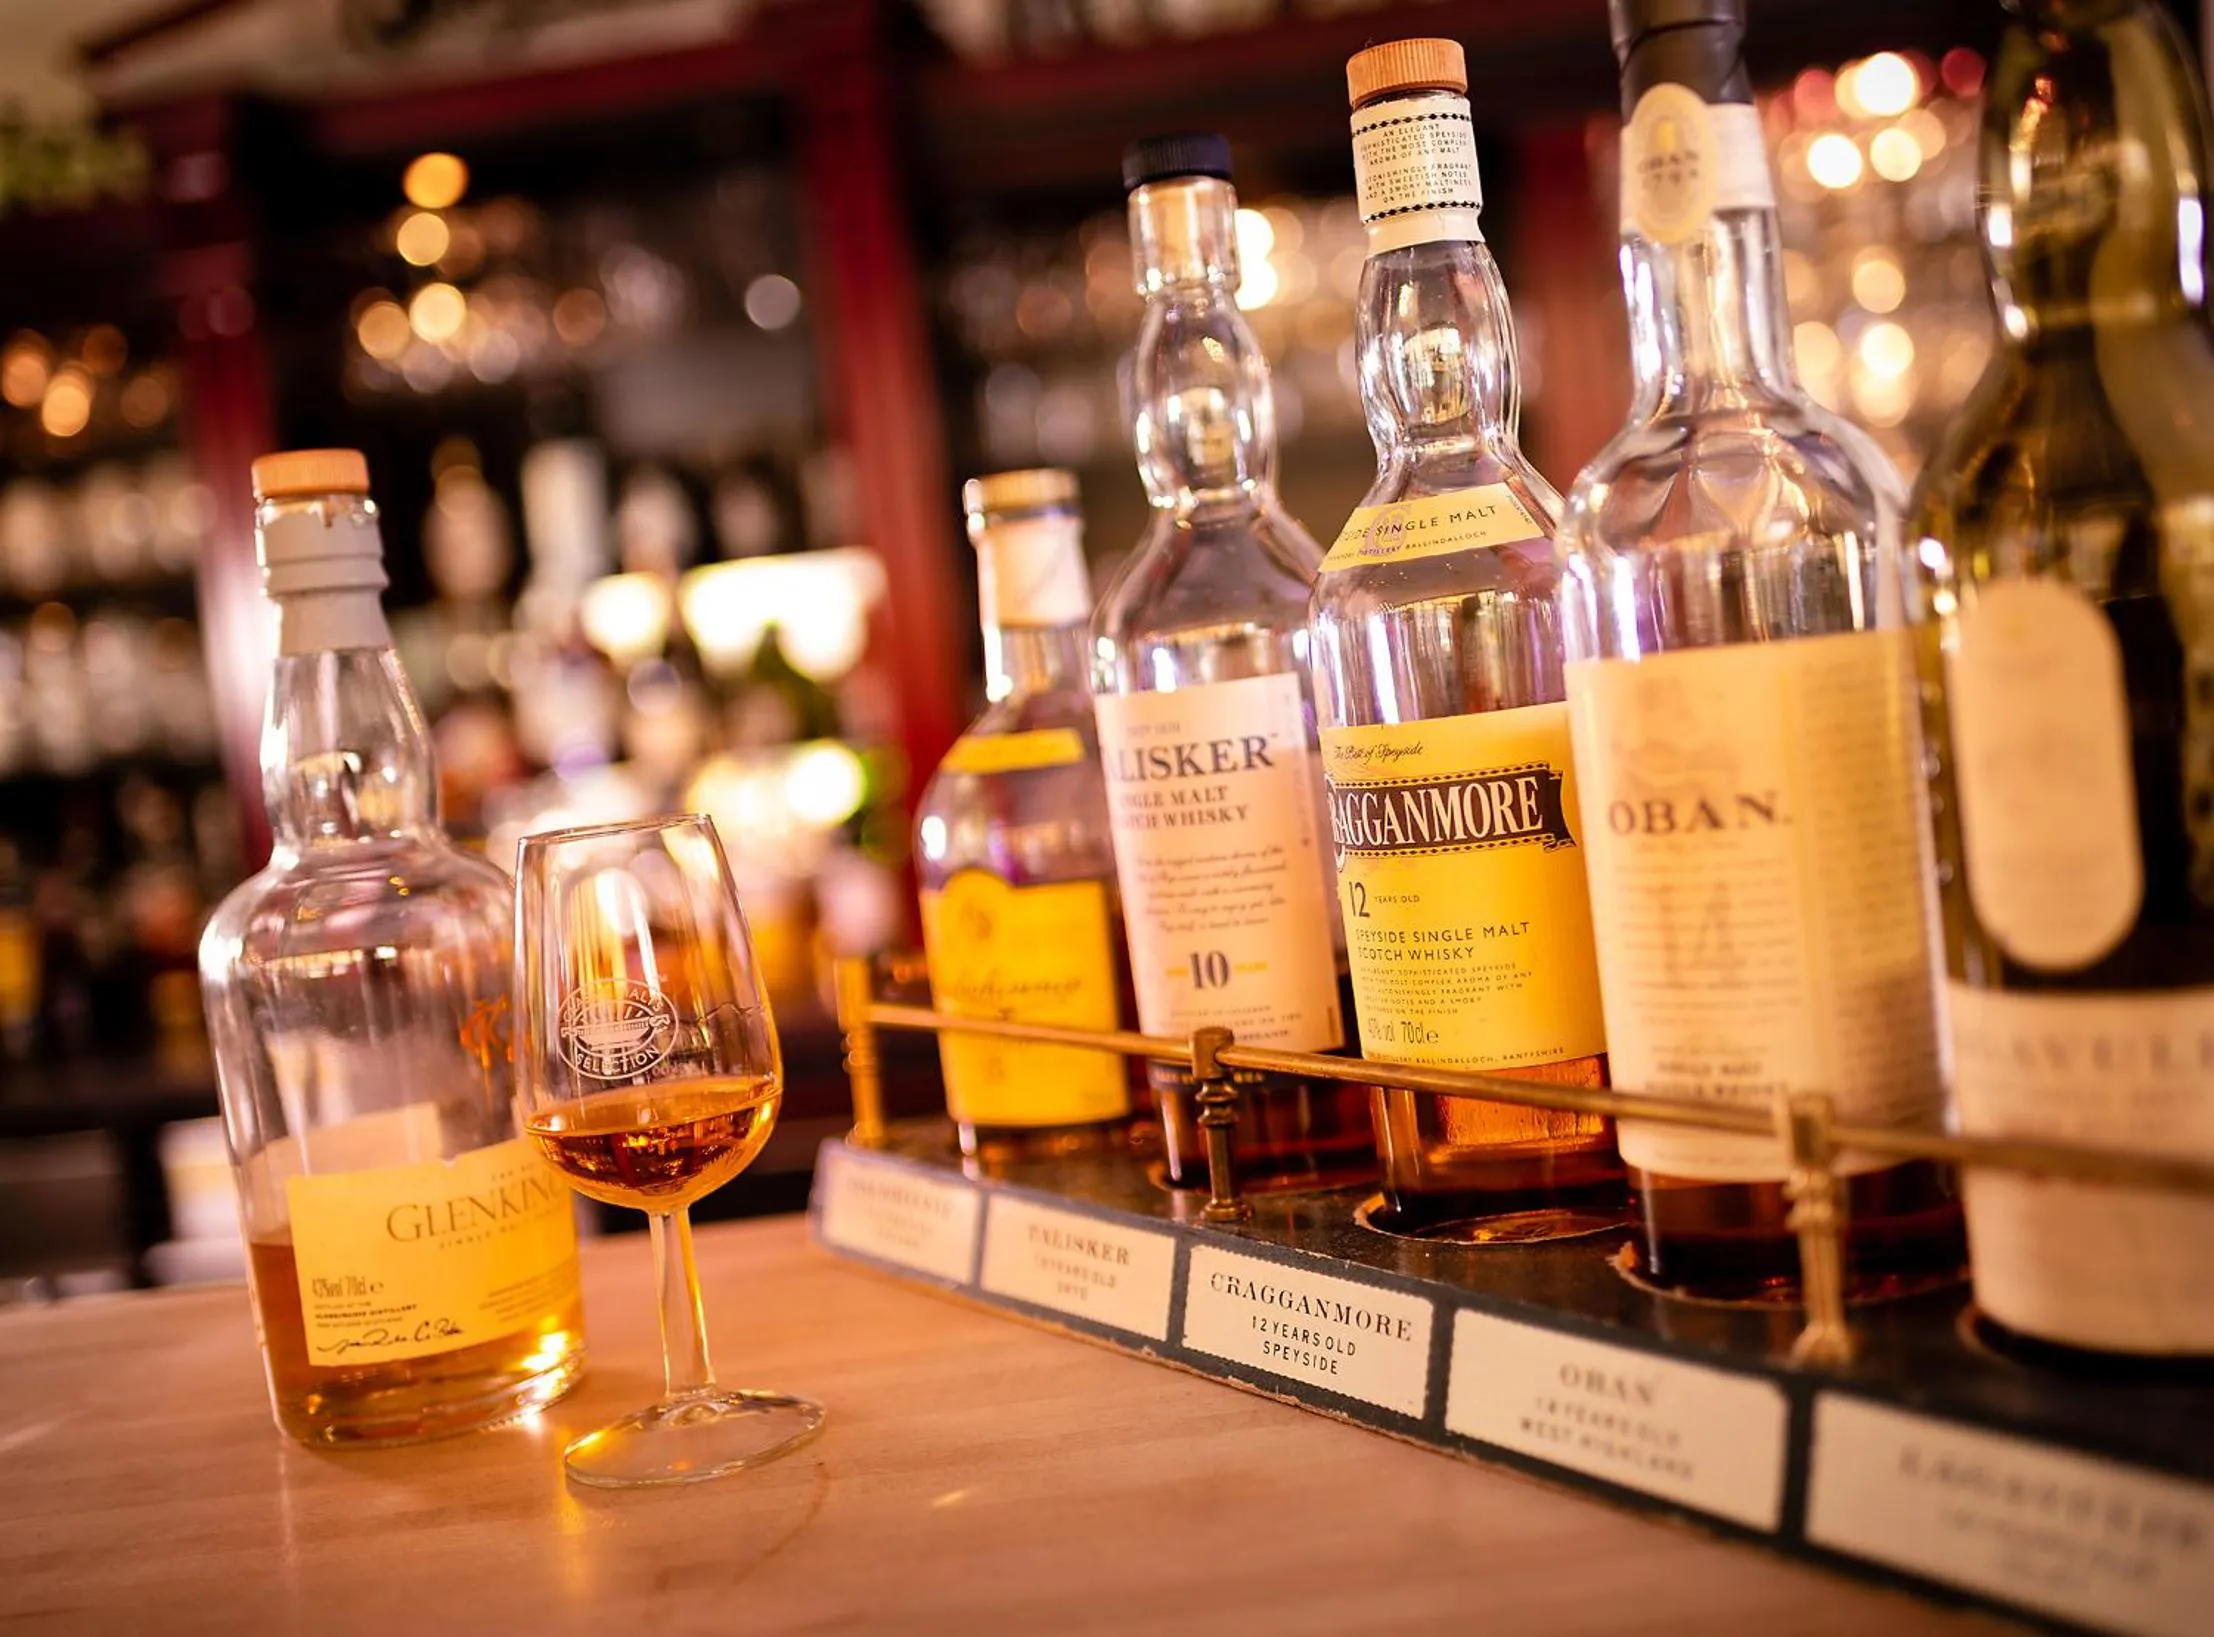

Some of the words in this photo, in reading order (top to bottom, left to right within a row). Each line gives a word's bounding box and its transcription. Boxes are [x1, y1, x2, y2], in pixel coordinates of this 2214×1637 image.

[1375, 517, 1439, 536] SINGLE
[1450, 505, 1497, 525] MALT
[1117, 735, 1275, 783] LISKER
[1171, 784, 1229, 806] MALT
[1326, 775, 1543, 850] RAGGANMORE
[1163, 804, 1249, 829] WHISKY
[1348, 881, 1371, 918] 12
[1401, 894, 1421, 903] OLD
[1355, 928, 1406, 944] SPEYSIDE
[1413, 927, 1474, 943] SINGLE
[1482, 921, 1530, 939] MALT
[1189, 950, 1230, 990] 10
[1358, 946, 1402, 962] SCOTCH
[1407, 946, 1475, 961] WHISKY
[576, 1044, 660, 1075] SELECTION
[1028, 1222, 1131, 1266] TALISKER
[1211, 1272, 1412, 1342] CRAGGANMORE
[1272, 1321, 1321, 1347] YEARS
[1325, 1335, 1357, 1357] OLD
[1263, 1340, 1338, 1375] SPEYSIDE
